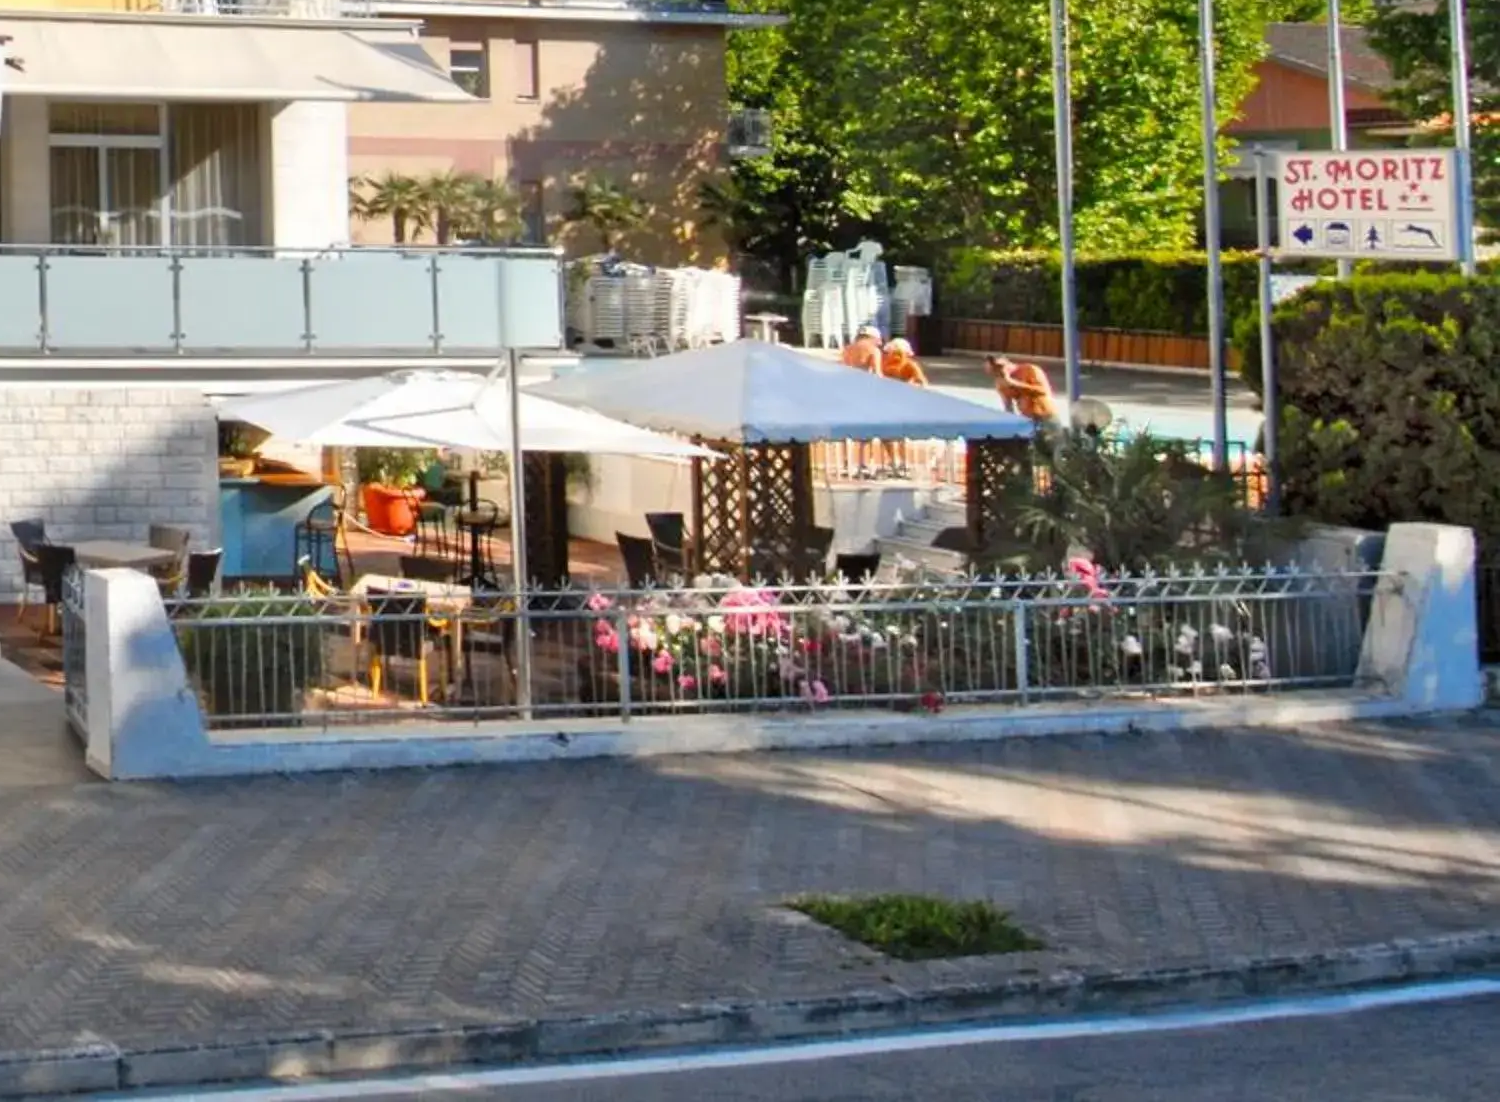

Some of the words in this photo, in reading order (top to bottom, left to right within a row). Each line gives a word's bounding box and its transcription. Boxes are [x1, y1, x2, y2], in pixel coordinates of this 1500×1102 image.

[1284, 159, 1318, 185] ST.
[1325, 157, 1445, 184] MORITZ
[1290, 188, 1389, 212] HOTEL
